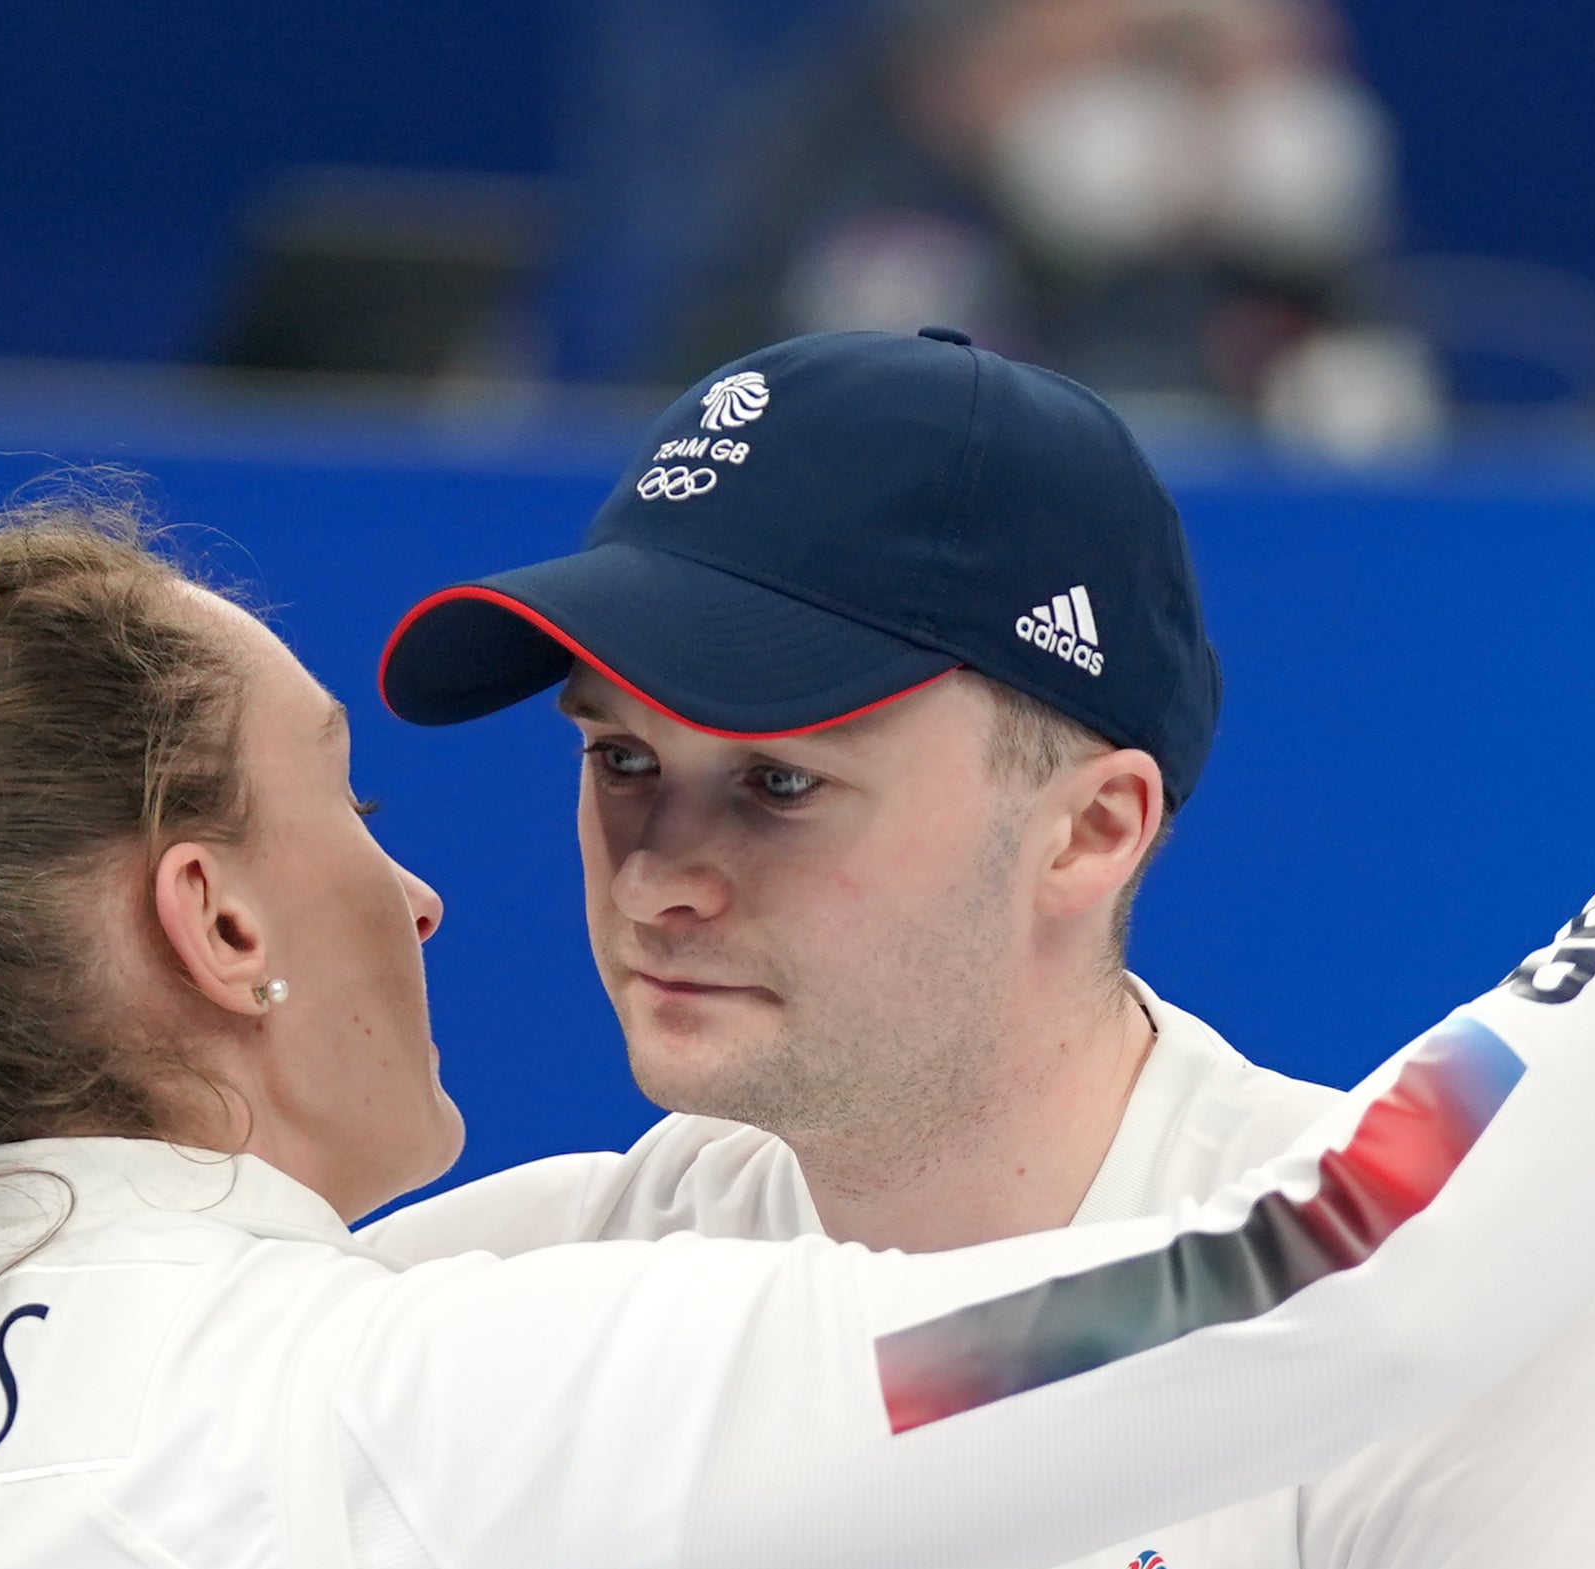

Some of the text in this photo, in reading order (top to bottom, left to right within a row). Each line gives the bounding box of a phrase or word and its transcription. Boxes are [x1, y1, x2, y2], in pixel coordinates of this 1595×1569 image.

[653, 437, 750, 464] TEAM GB
[1015, 615, 1104, 676] adidas
